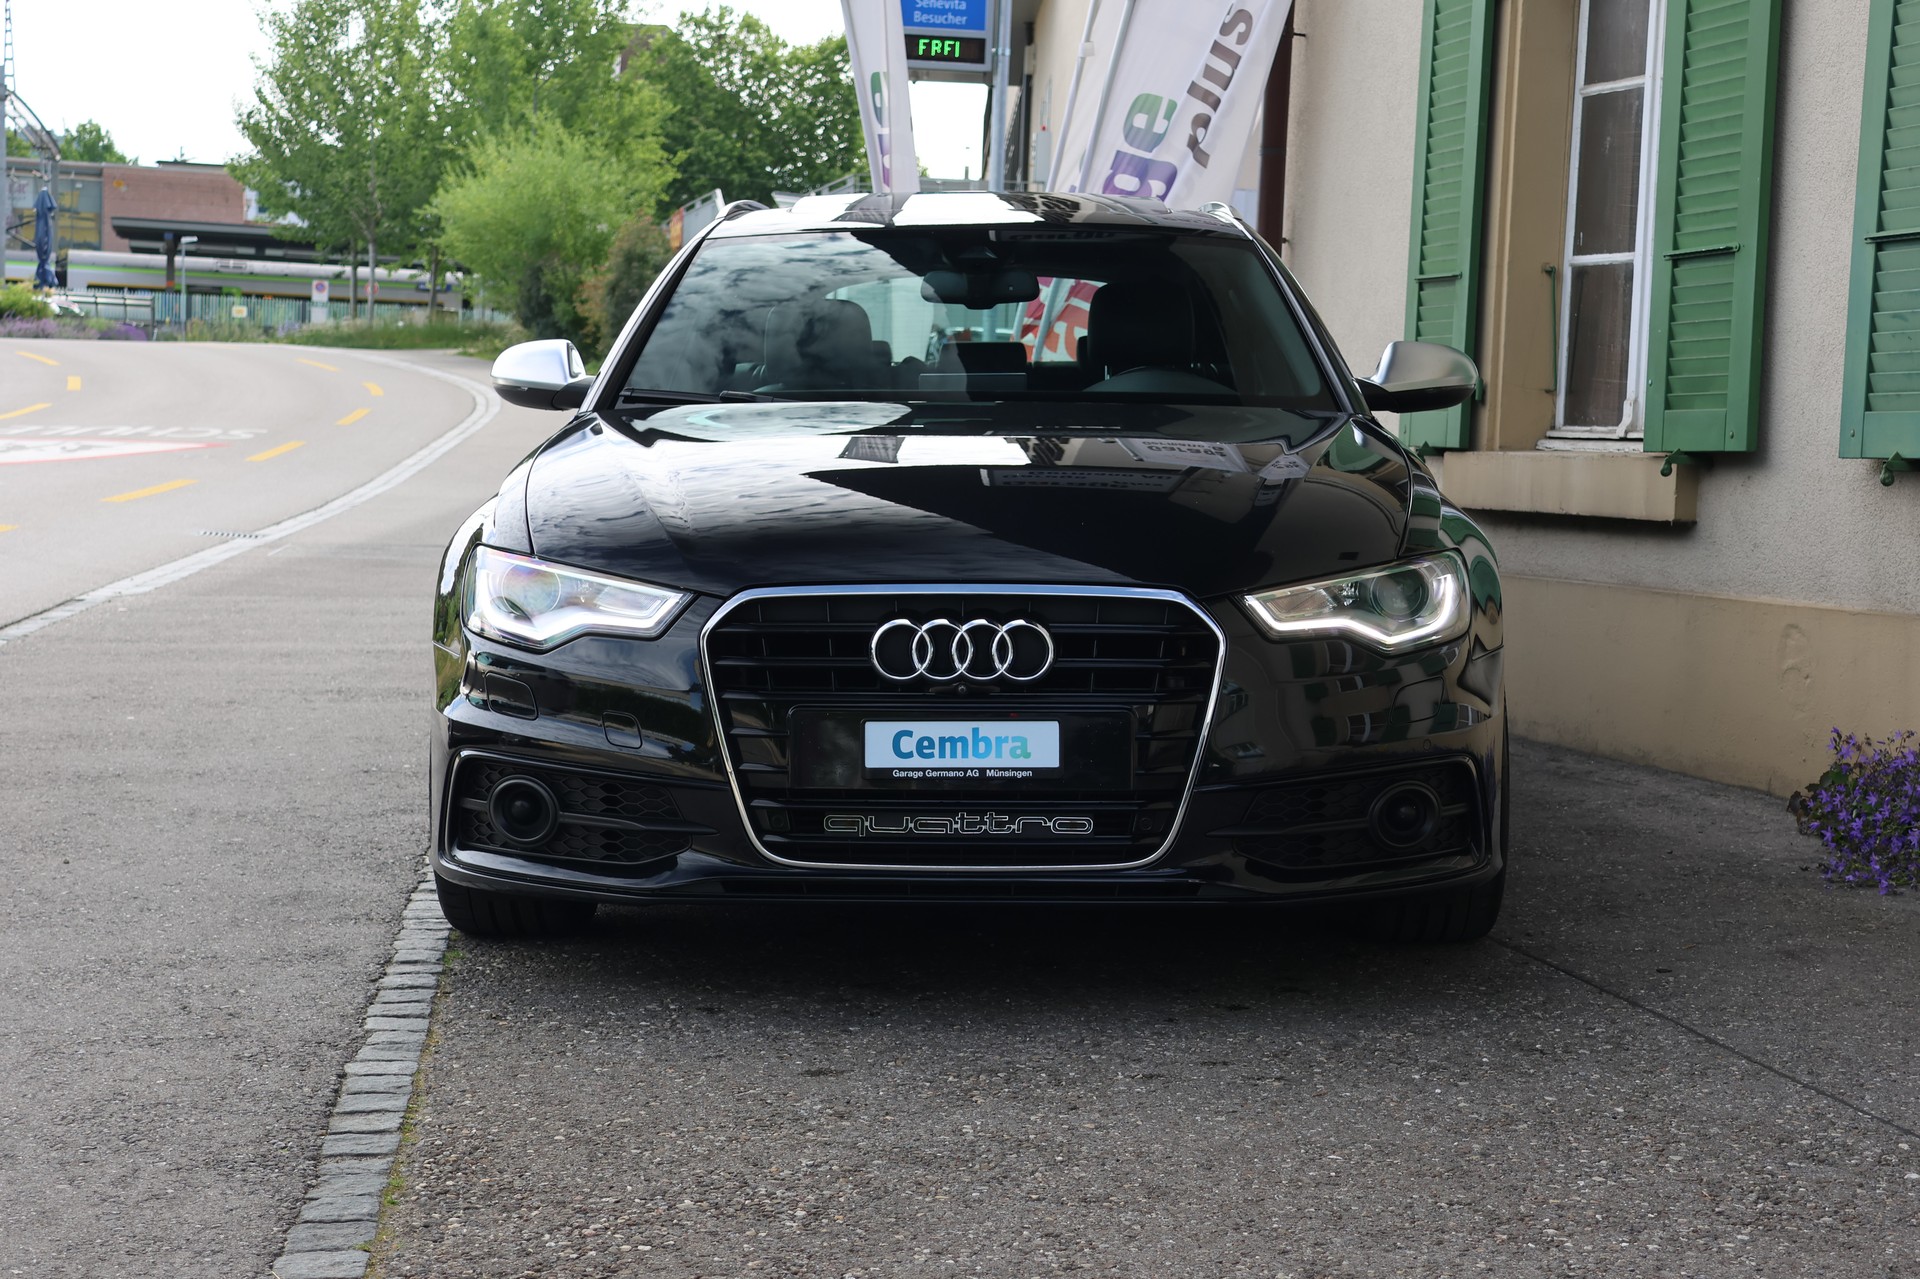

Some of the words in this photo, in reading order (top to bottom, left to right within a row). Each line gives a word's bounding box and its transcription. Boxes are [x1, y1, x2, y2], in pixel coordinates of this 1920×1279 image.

[915, 0, 967, 10] Senevita
[913, 11, 968, 25] Besucher
[892, 727, 1032, 760] Cembra
[892, 769, 924, 779] Garage
[925, 769, 965, 777] Germano
[966, 769, 980, 777] AG
[986, 769, 1033, 779] Münsingen
[823, 812, 1094, 837] quattro
